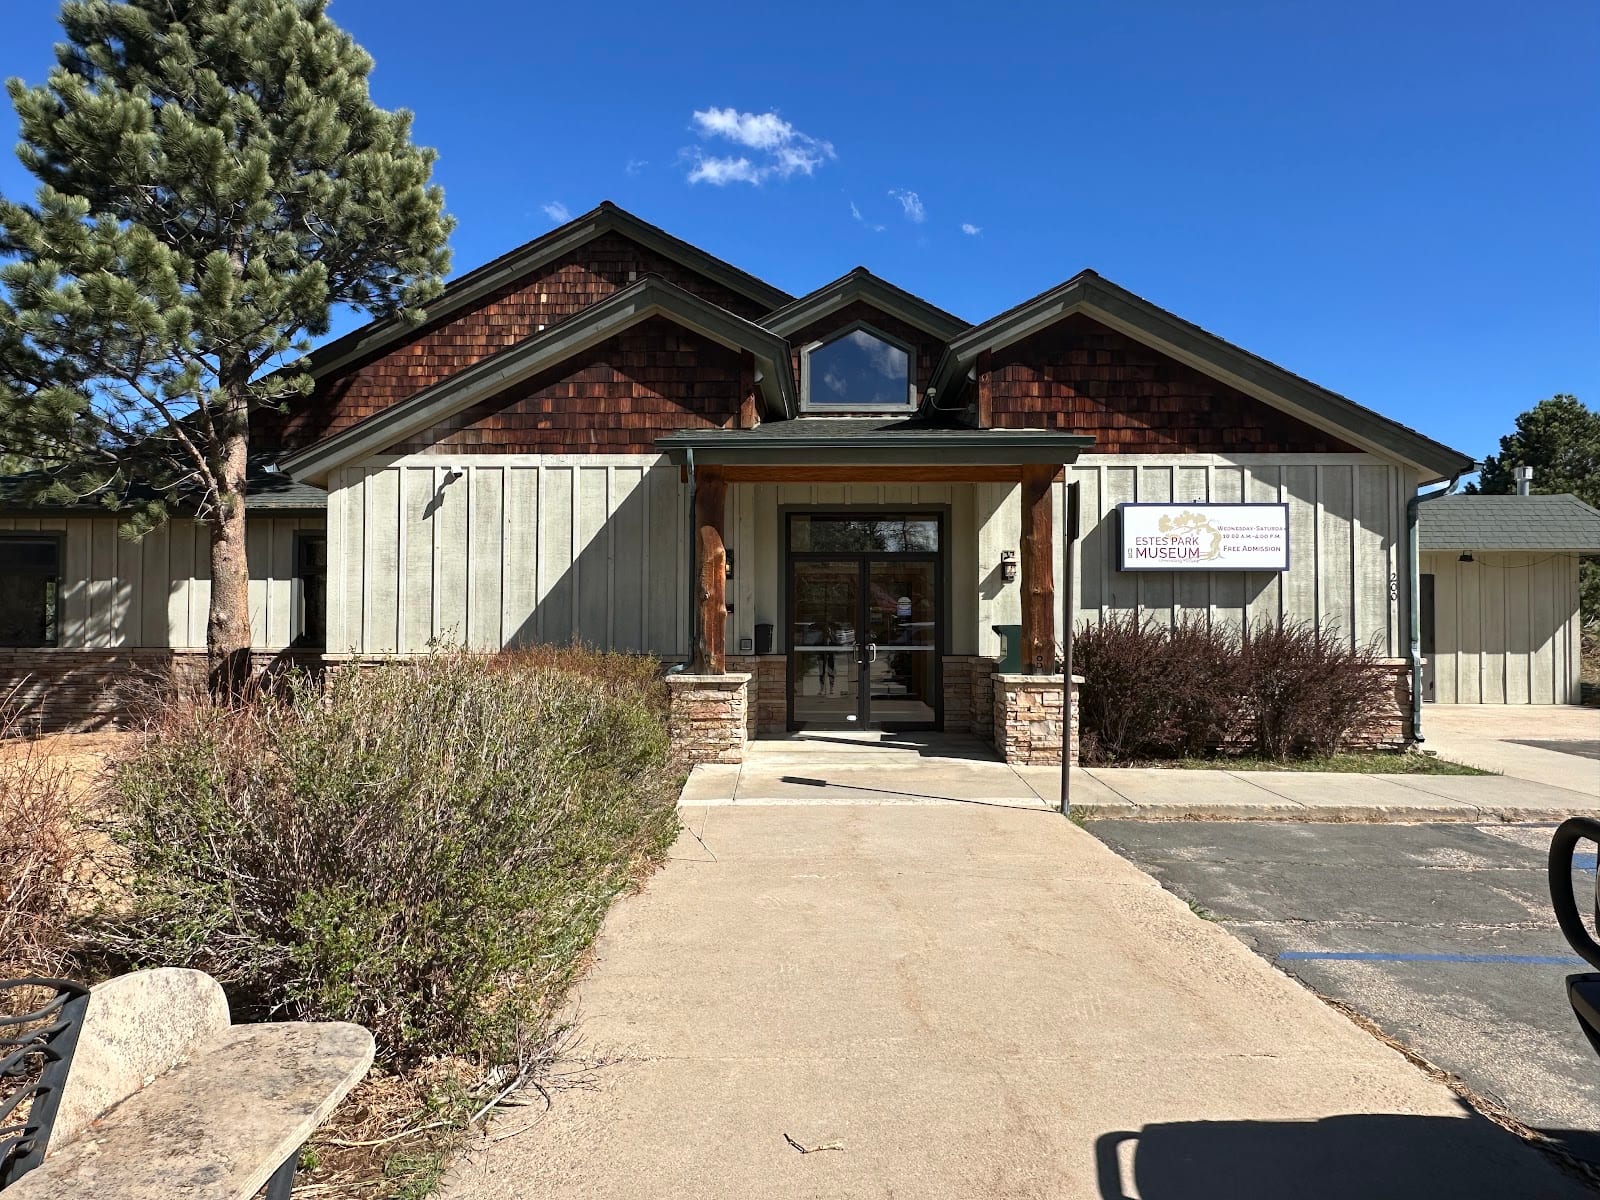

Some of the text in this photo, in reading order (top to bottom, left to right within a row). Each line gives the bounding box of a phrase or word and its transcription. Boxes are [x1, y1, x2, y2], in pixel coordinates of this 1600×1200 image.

[1135, 536, 1200, 546] ESTES PARK
[1135, 547, 1200, 559] MUSEUM
